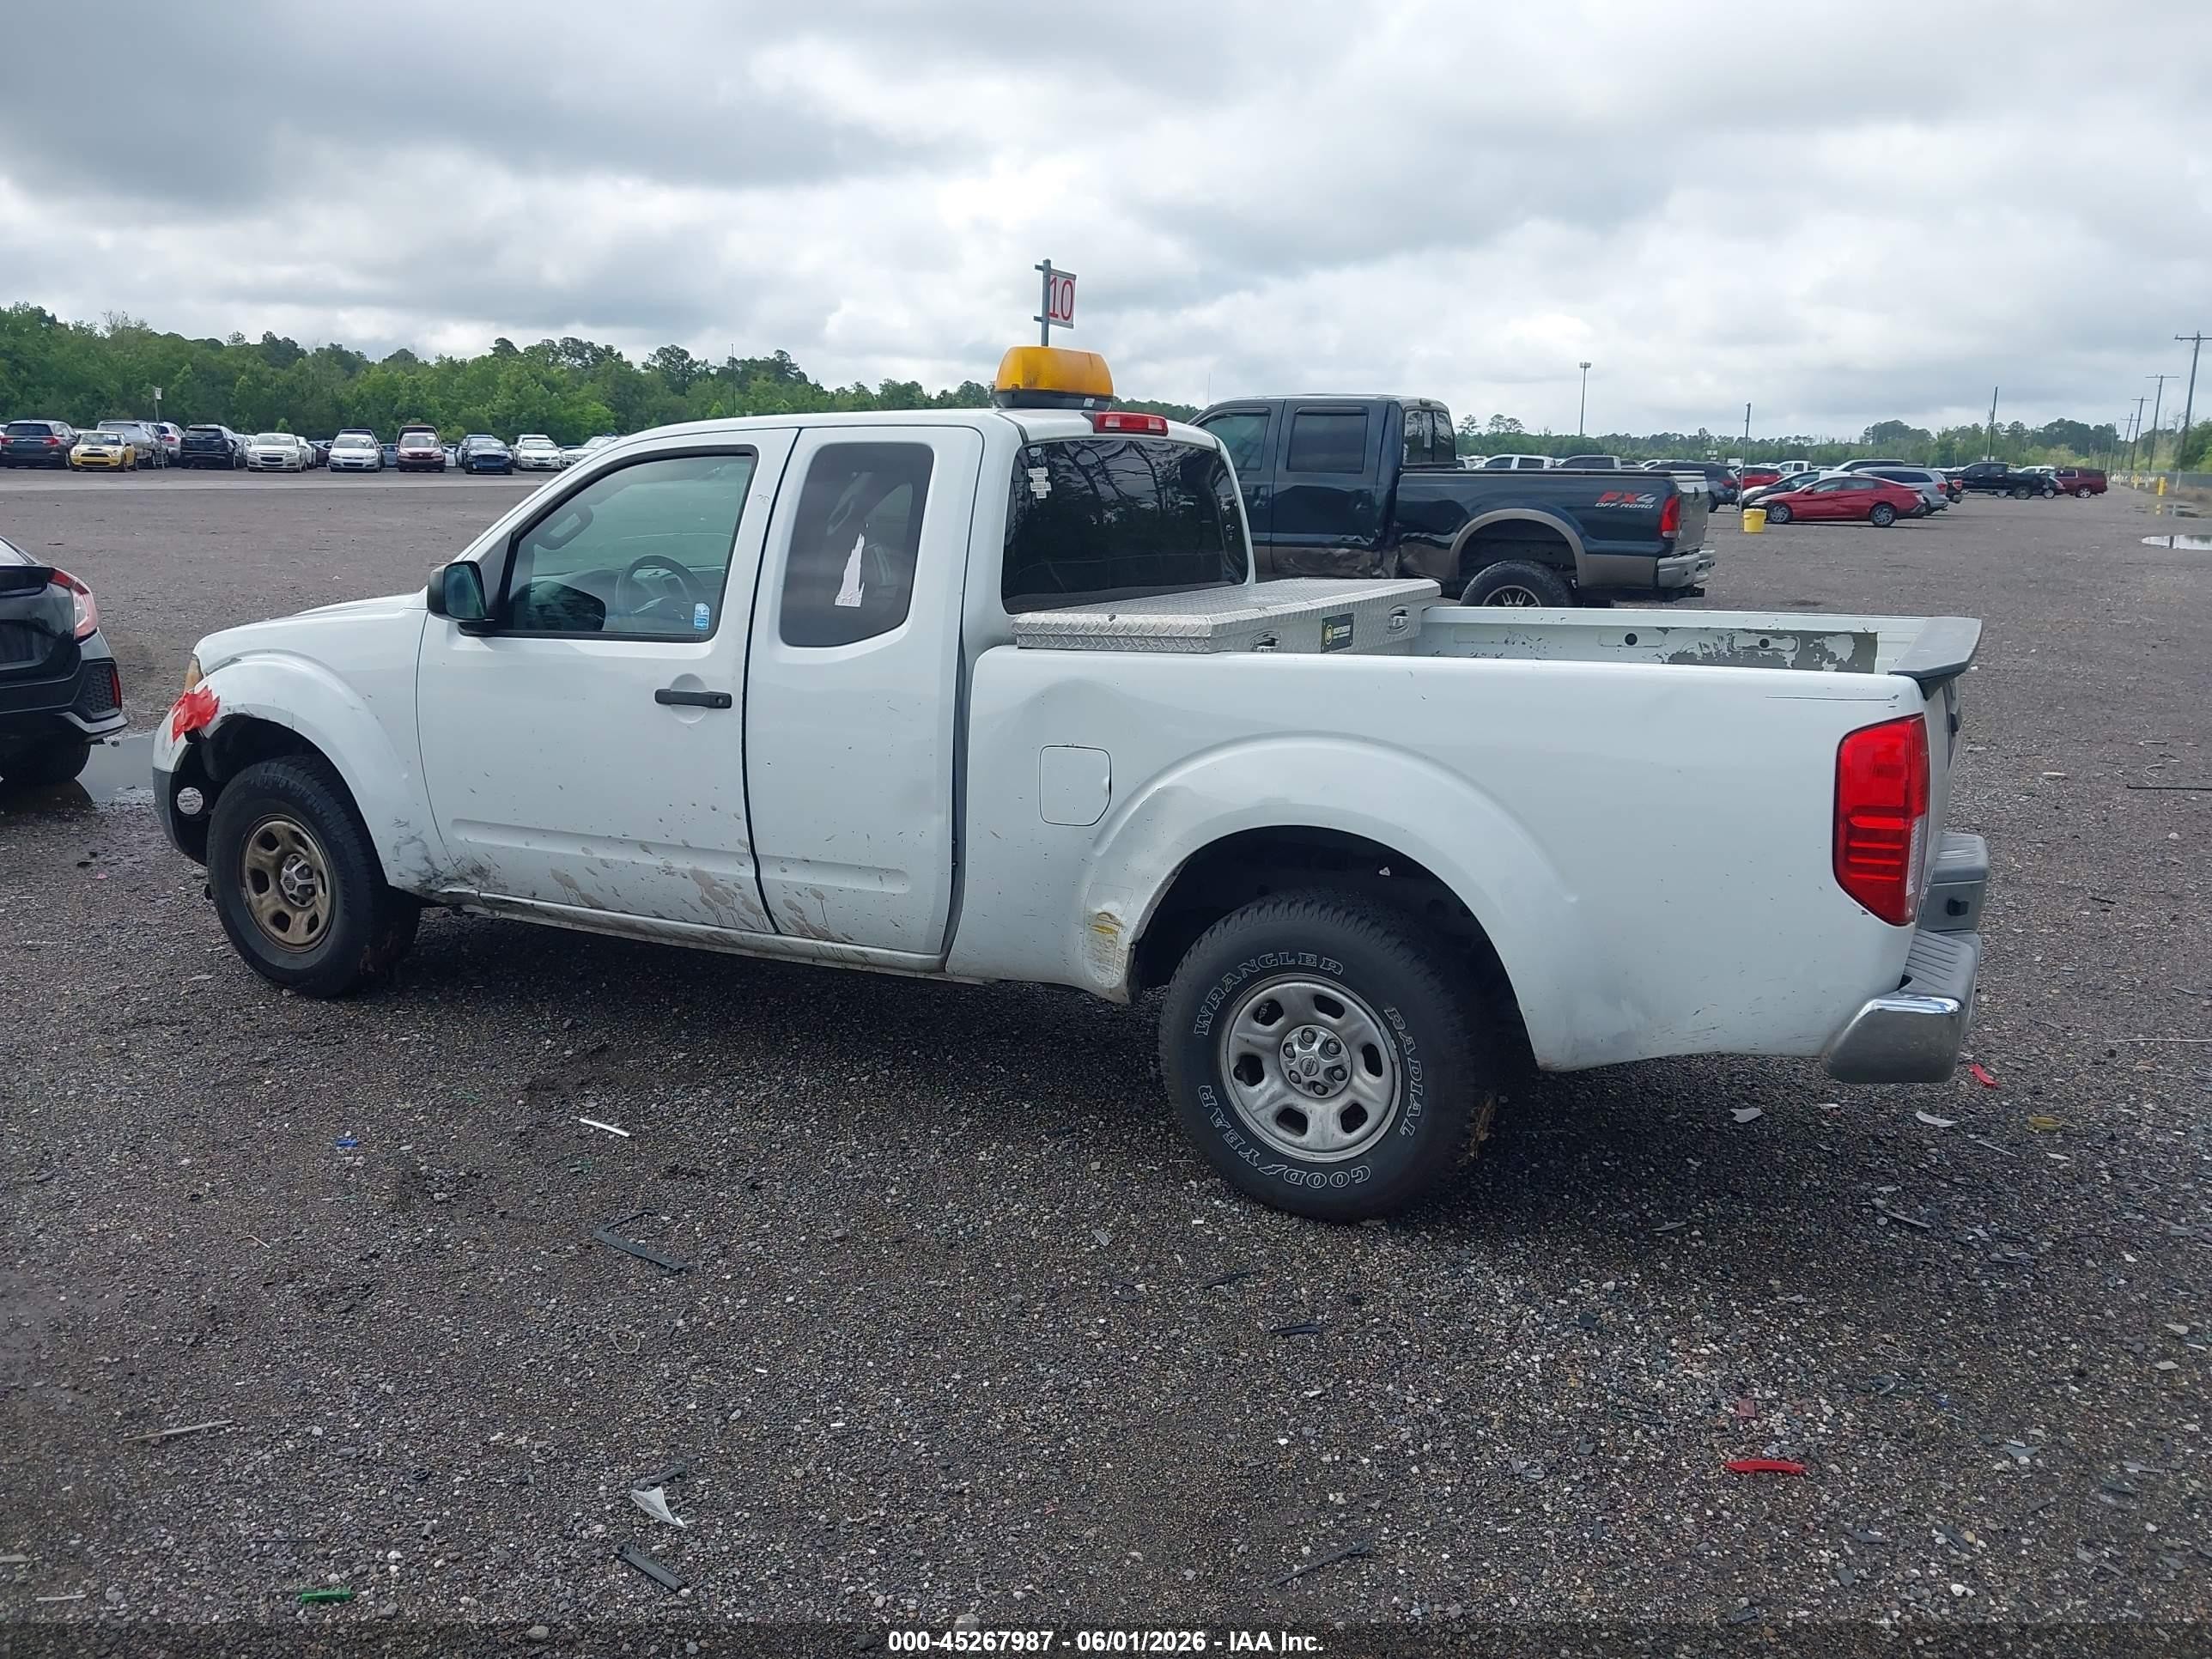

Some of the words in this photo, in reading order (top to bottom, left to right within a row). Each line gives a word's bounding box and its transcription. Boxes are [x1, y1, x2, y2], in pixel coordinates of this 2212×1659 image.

[1048, 276, 1073, 321] 10
[1596, 490, 1656, 503] FX4
[1194, 952, 1344, 1036] WRANGLER
[1383, 1007, 1423, 1137] RADIAL
